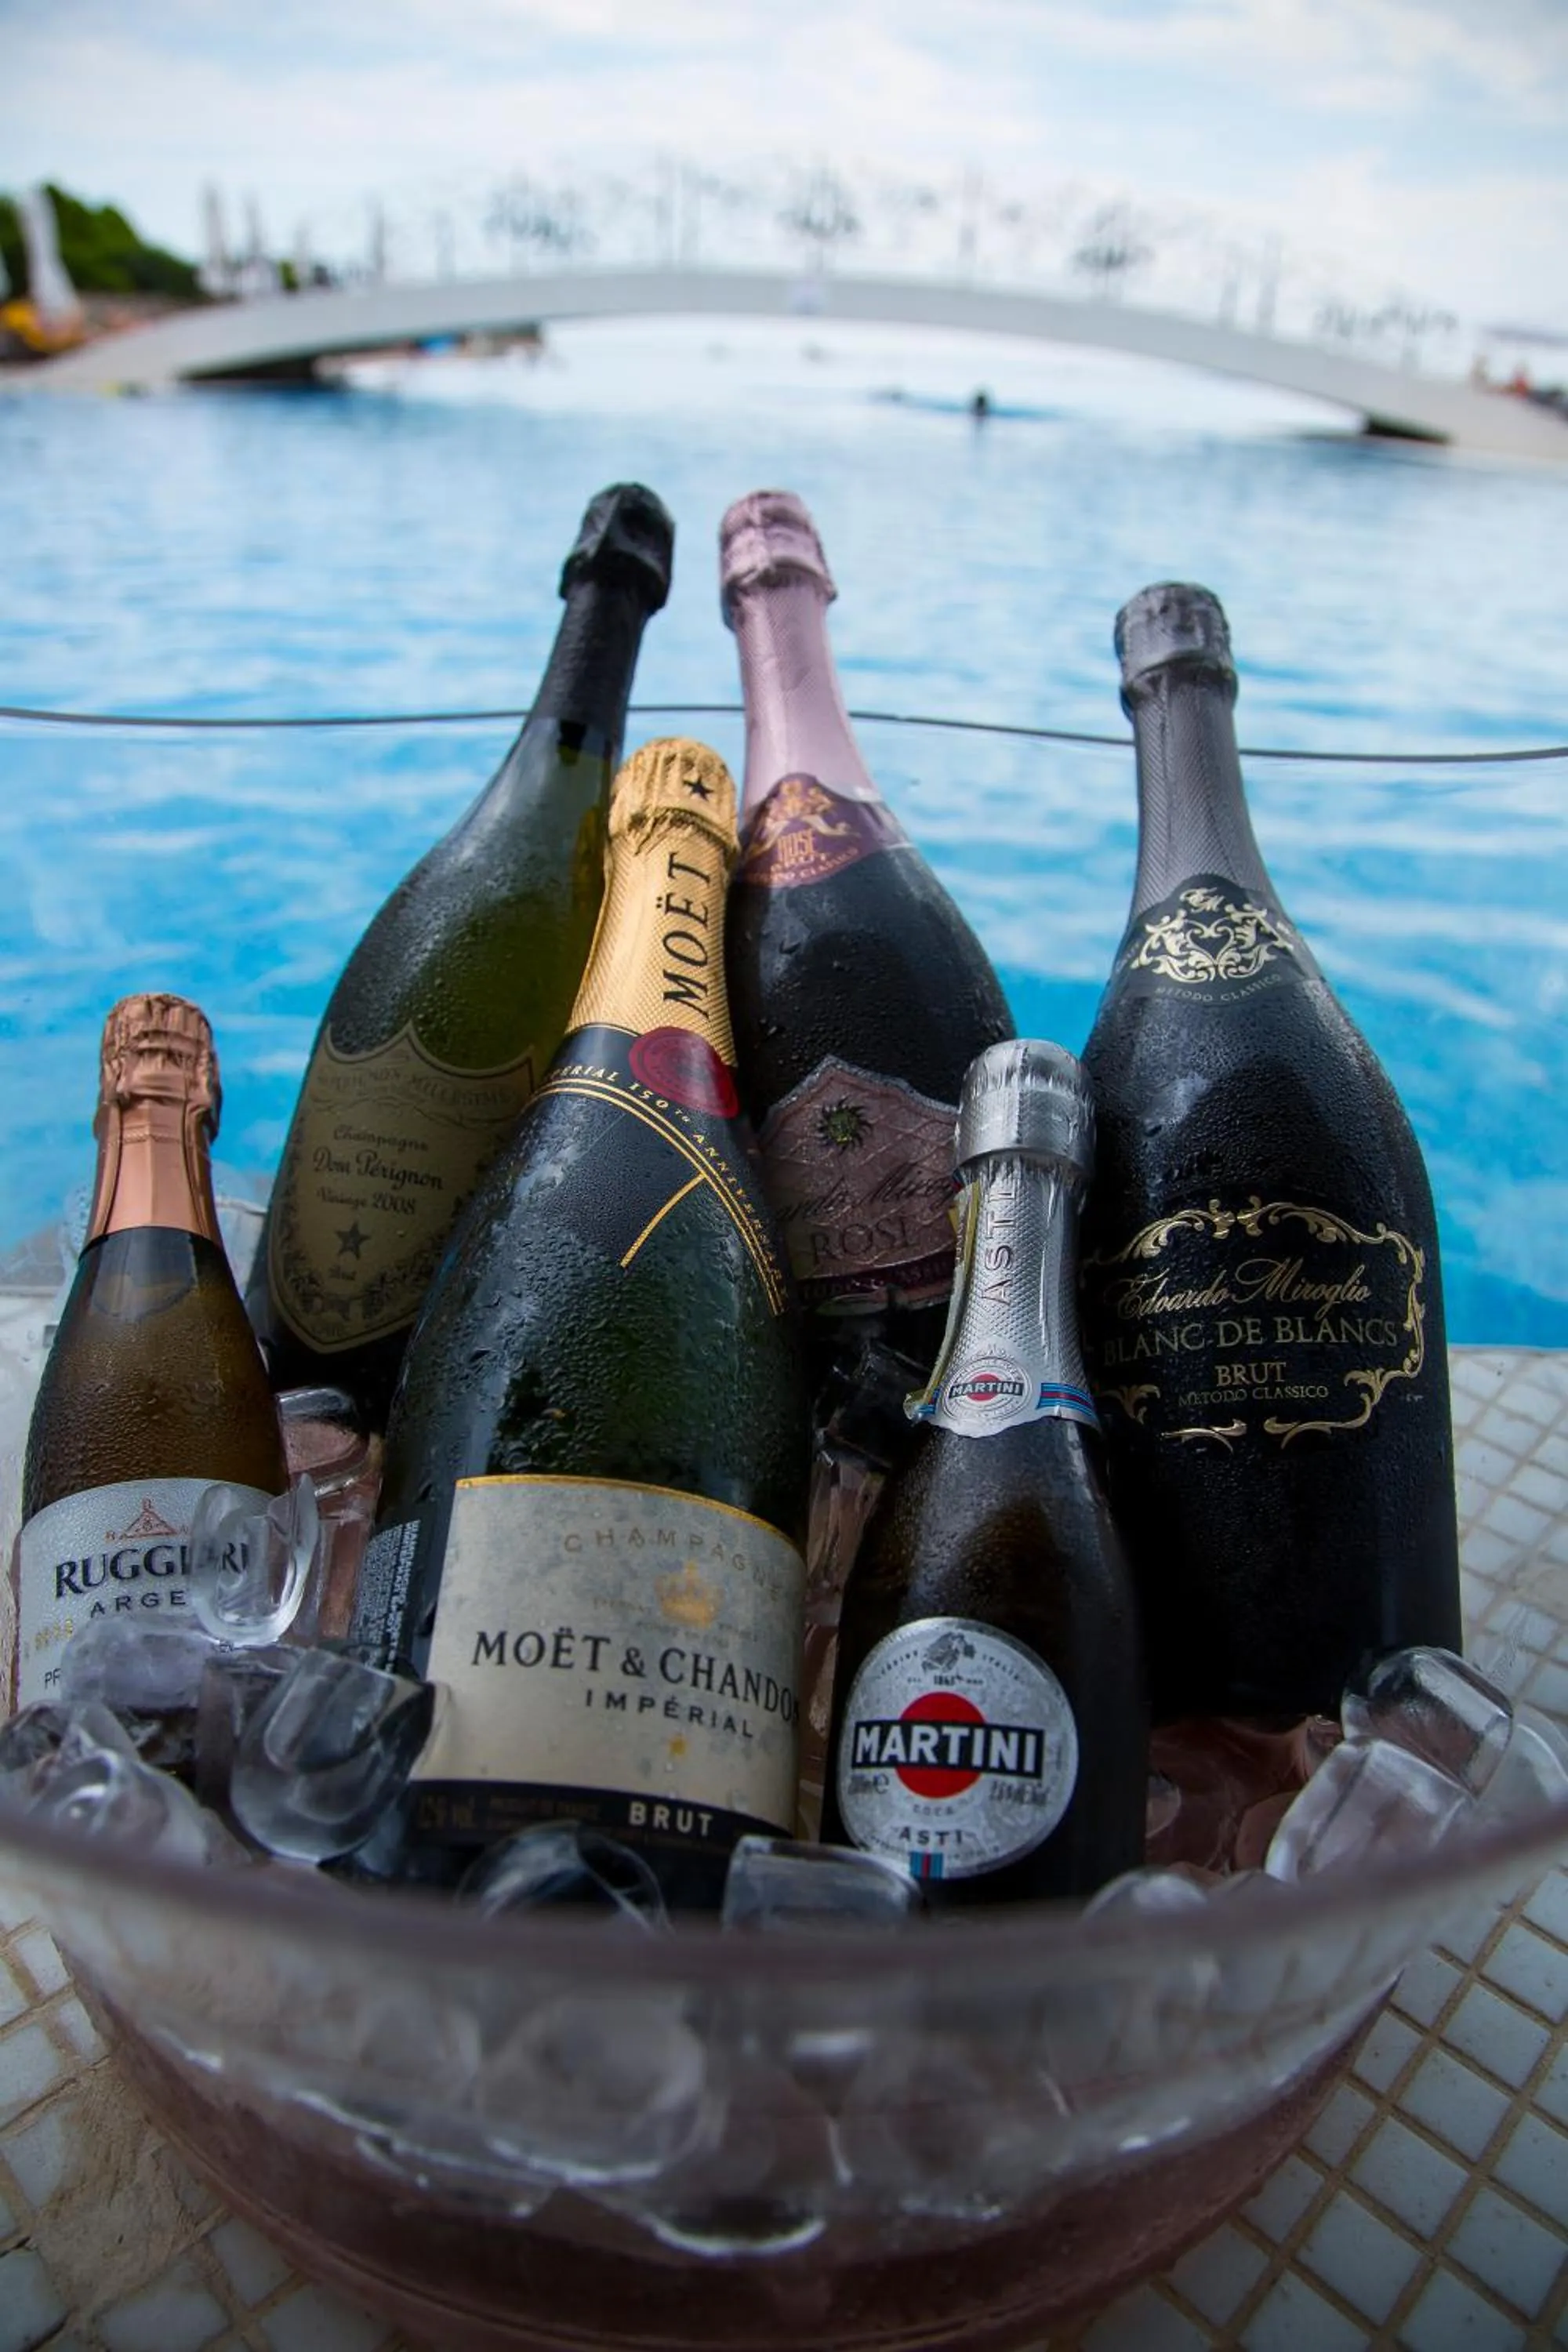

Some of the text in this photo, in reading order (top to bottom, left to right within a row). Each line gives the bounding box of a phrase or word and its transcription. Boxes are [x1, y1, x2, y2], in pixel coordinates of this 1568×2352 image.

[655, 851, 710, 1019] MOËT
[333, 1124, 429, 1152] Champagne
[313, 1146, 444, 1191] Dom Pérignon
[372, 1191, 416, 1215] 2008
[979, 1192, 1016, 1307] ASTI
[1112, 1256, 1373, 1319] Edoardo Miroglio
[1104, 1317, 1398, 1367] BLANC DE BLANCS
[952, 1382, 1020, 1396] MARTINI
[1215, 1362, 1287, 1388] BRUT
[1178, 1385, 1330, 1407] METODO CLASSICO
[90, 1590, 187, 1617] ARGE
[471, 1628, 612, 1673] MOËT
[619, 1646, 648, 1678] &
[586, 1687, 754, 1738] IMPÉRIAL
[855, 1725, 1039, 1773] MARTINI
[628, 1801, 713, 1837] BRUT
[898, 1825, 963, 1846] ASTI
